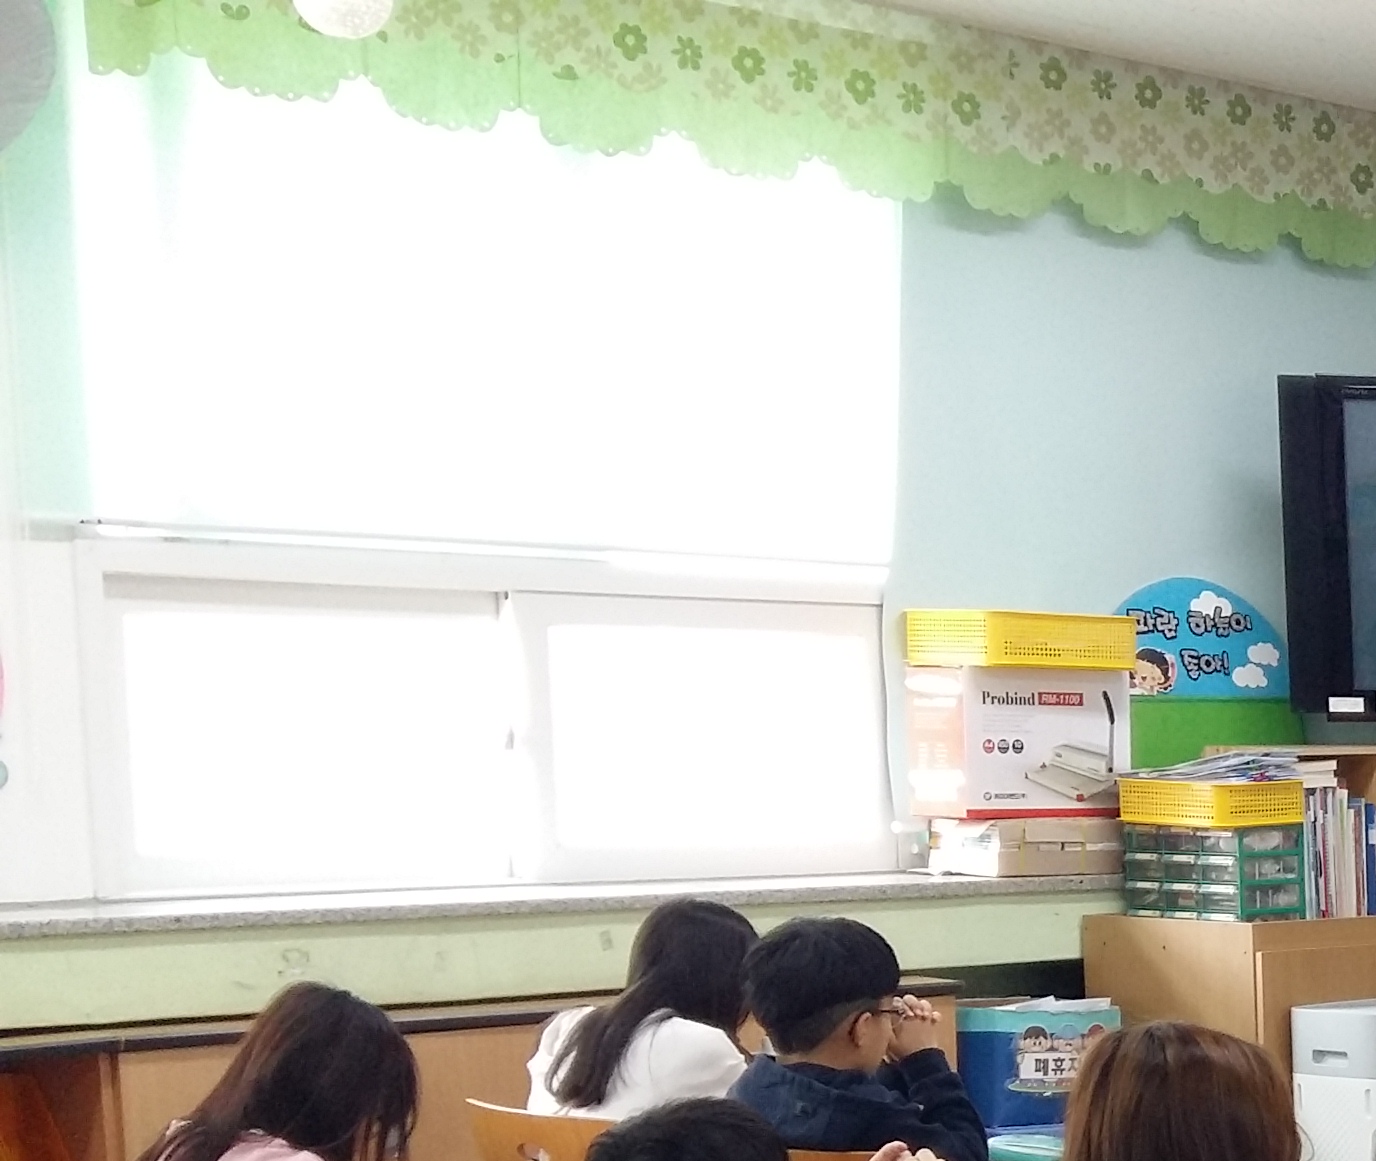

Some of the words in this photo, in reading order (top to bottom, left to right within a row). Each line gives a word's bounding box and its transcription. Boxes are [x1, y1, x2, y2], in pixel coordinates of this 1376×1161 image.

[1126, 606, 1179, 640] 파란
[1187, 605, 1253, 638] 하늘이
[1180, 648, 1230, 680] 좋아!
[982, 690, 1036, 706] Probind
